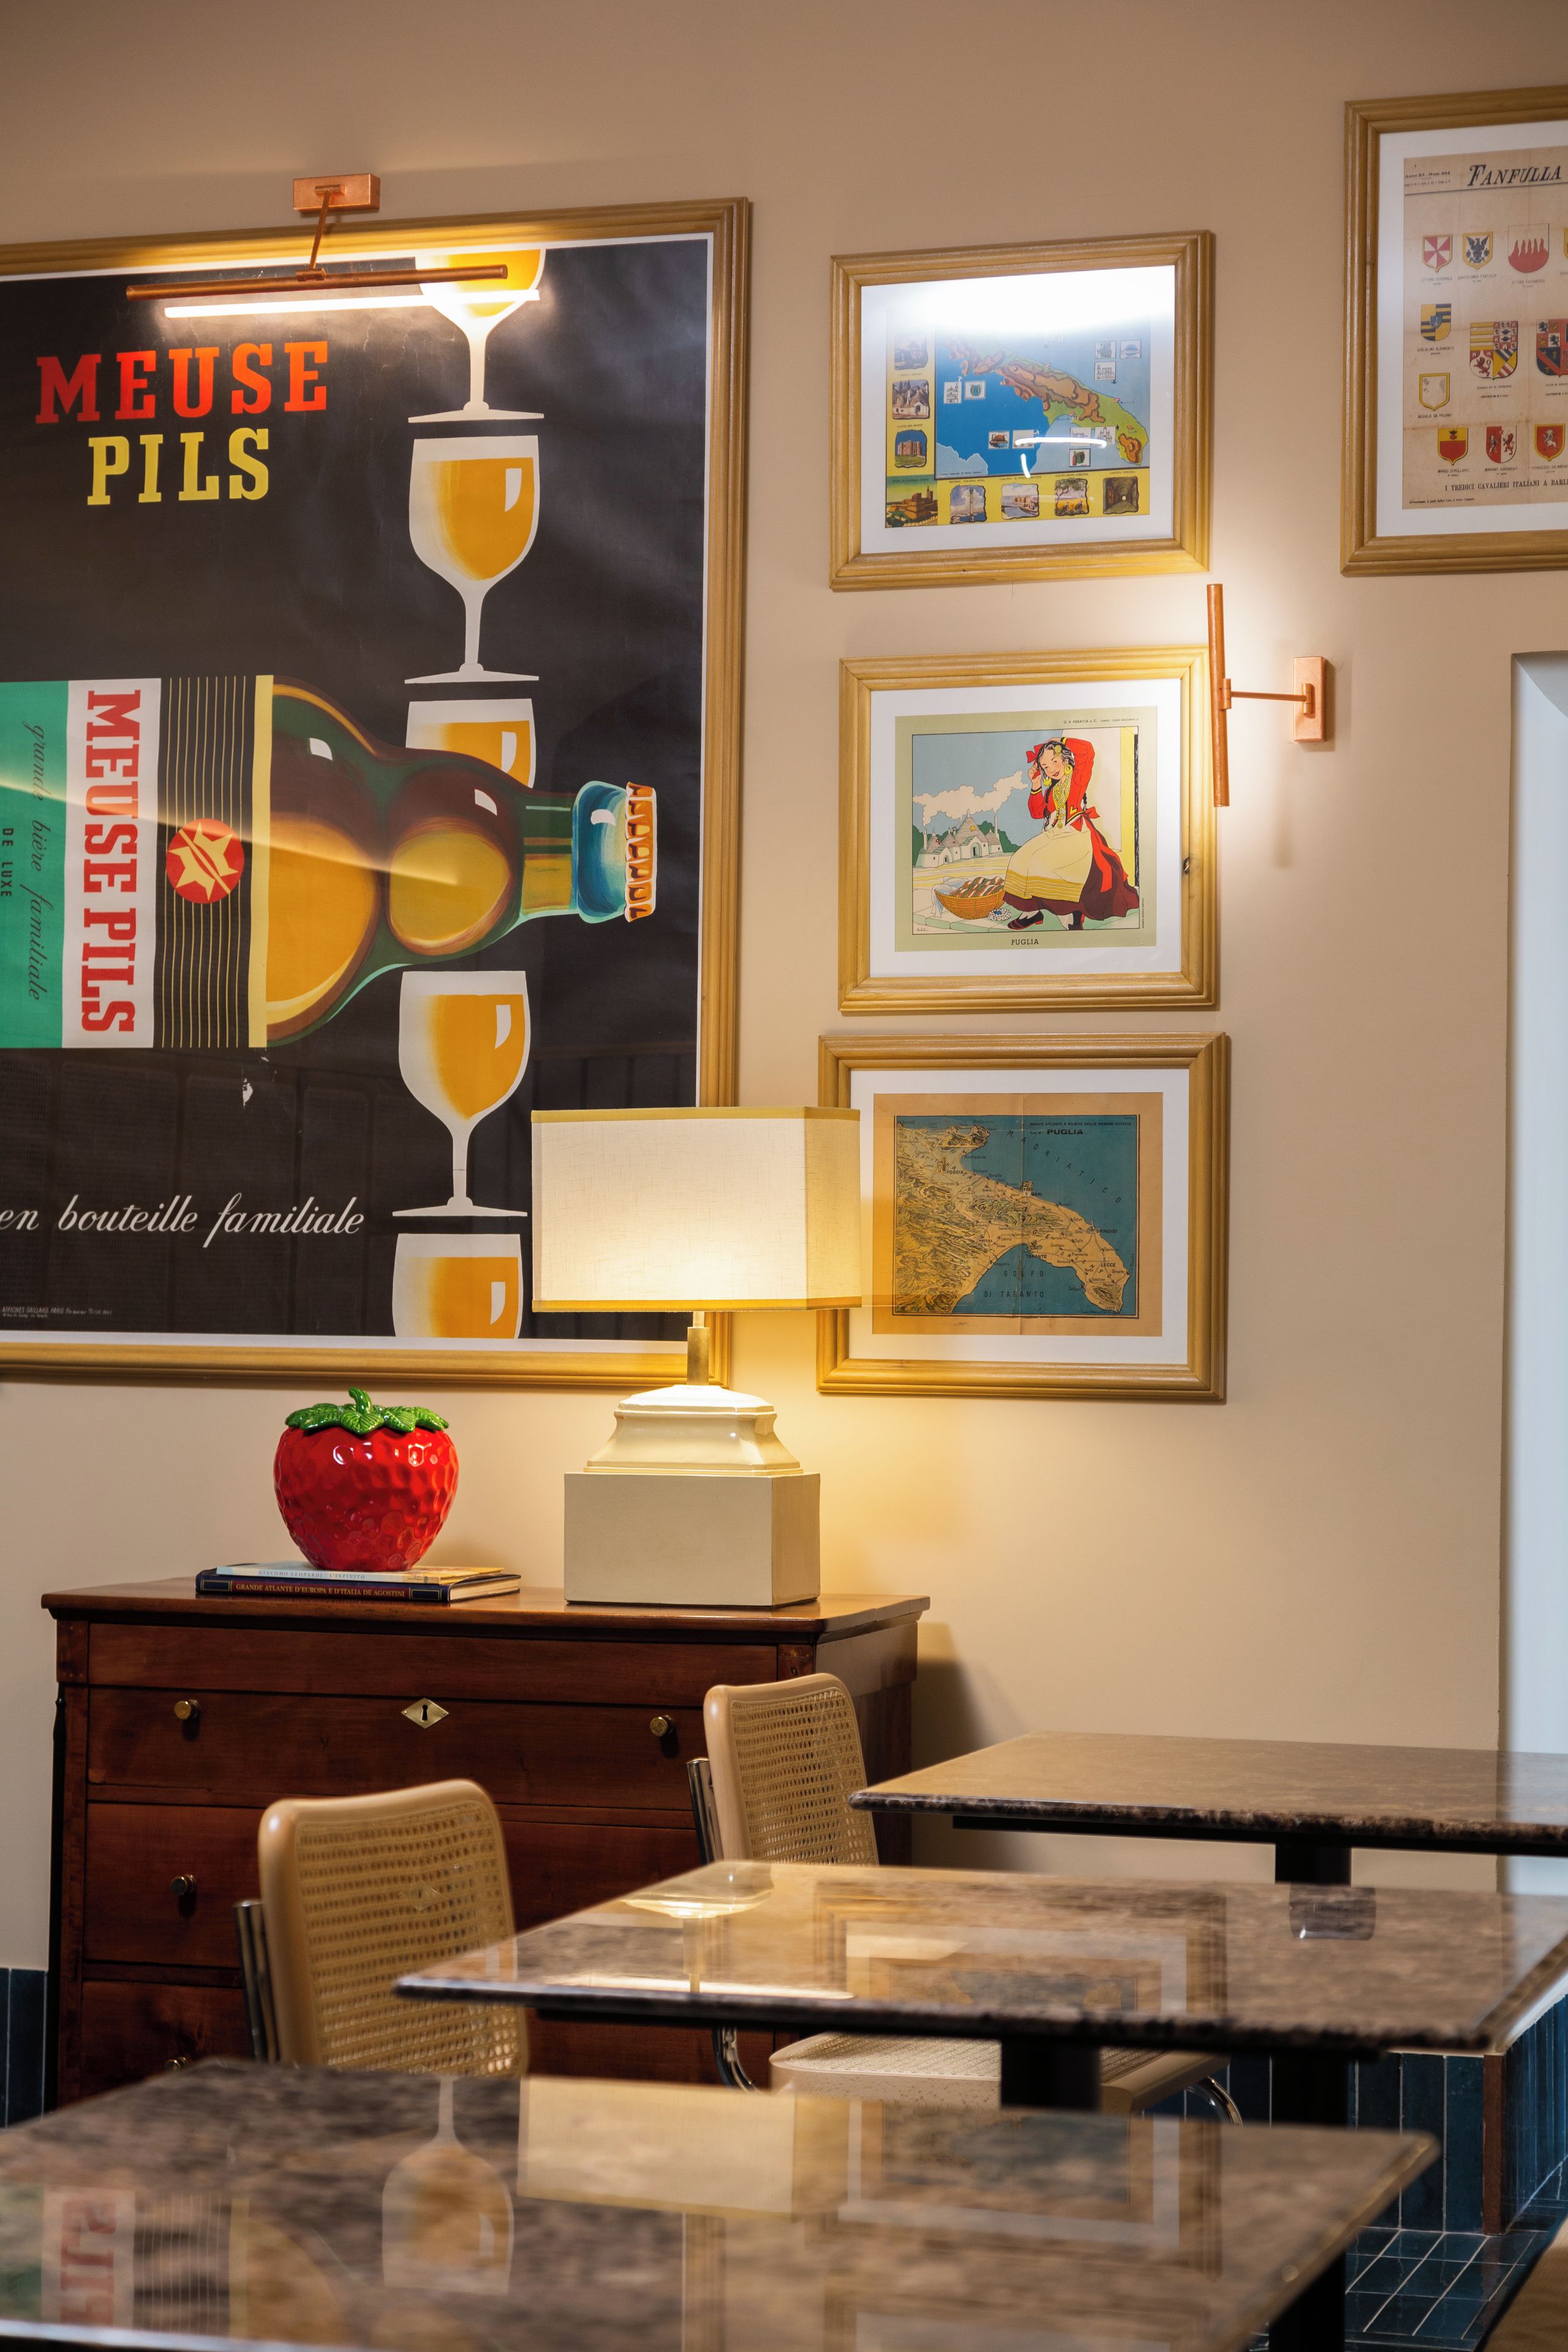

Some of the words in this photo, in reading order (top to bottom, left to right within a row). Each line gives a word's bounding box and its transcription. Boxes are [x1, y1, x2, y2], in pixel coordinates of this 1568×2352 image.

[1467, 164, 1561, 186] FANFULLA
[36, 341, 328, 424] MEUSE
[87, 427, 269, 505] PILS
[22, 720, 45, 802] grande
[83, 690, 141, 893] MEUSE
[2, 828, 13, 846] DE
[31, 819, 51, 872] bière
[1, 862, 13, 897] LUXE
[20, 884, 54, 1001] familiale
[81, 907, 136, 1032] PILS
[0, 1208, 39, 1231] en
[58, 1194, 198, 1231] bouteille
[203, 1193, 364, 1248] familiale
